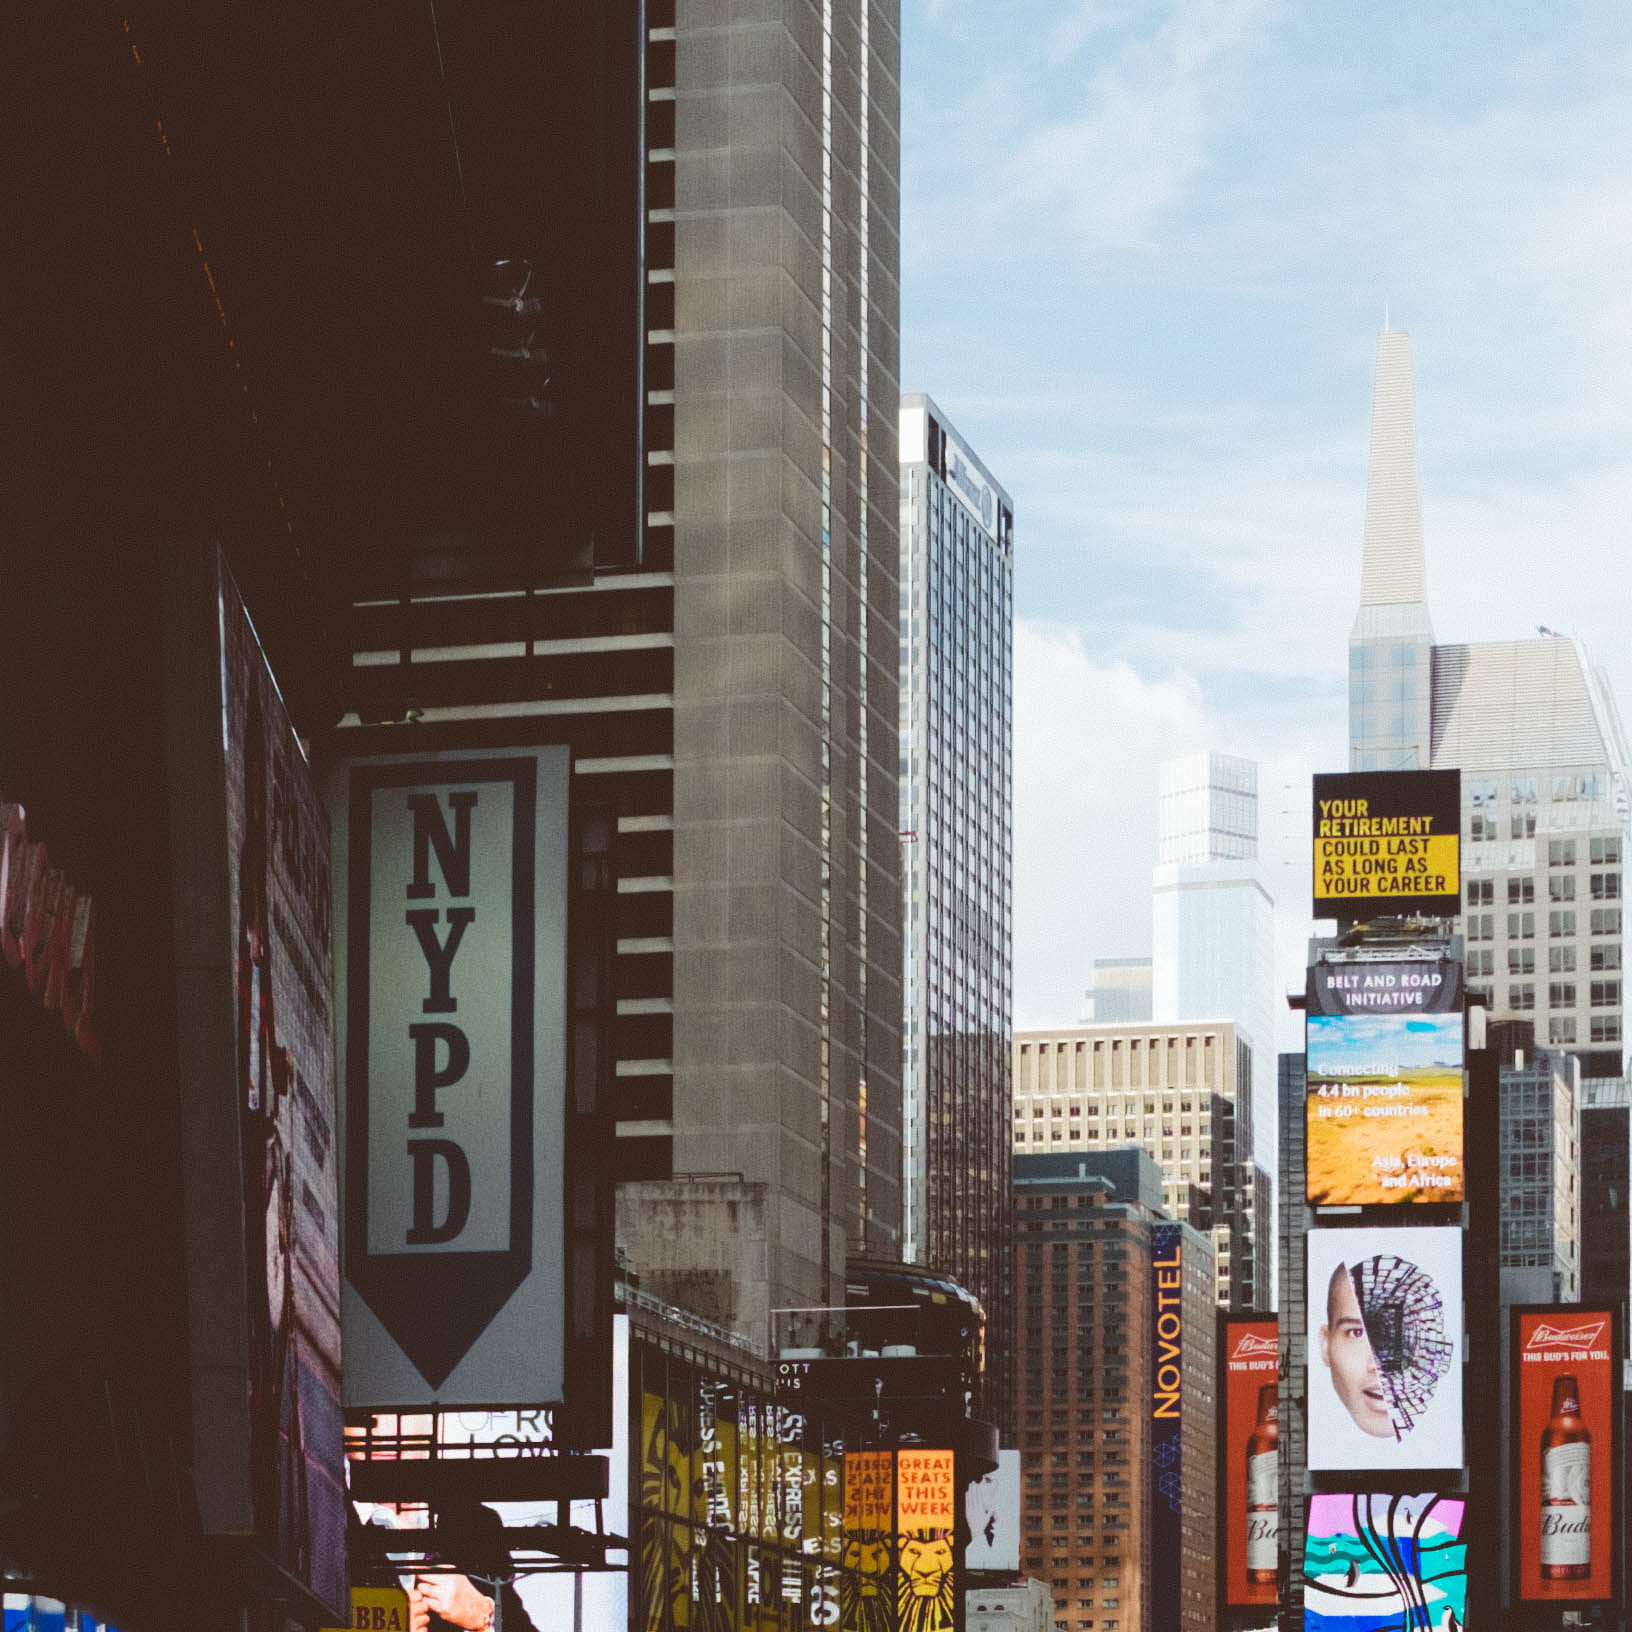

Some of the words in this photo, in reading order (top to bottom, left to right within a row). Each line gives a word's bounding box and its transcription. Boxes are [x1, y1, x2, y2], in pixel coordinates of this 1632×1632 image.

[1319, 799, 1368, 818] YOUR
[1319, 817, 1434, 838] RETIREMENT
[1322, 840, 1380, 858] COULD
[1387, 838, 1431, 856] LAST
[1322, 859, 1345, 876] AS
[1352, 858, 1398, 875] LONG
[1405, 857, 1428, 874] AS
[1323, 877, 1370, 894] YOUR
[1377, 875, 1446, 892] CAREER
[1327, 975, 1359, 989] BELT
[1363, 974, 1396, 988] AND
[1401, 973, 1442, 987] ROAD
[1346, 991, 1423, 1006] INITIATIVE
[405, 791, 480, 1245] NYPD
[1318, 1084, 1339, 1098] 4.4
[1342, 1083, 1360, 1097] bn
[1362, 1082, 1411, 1099] people
[1363, 1102, 1428, 1117] countries
[1407, 1154, 1457, 1169] Europe
[1381, 1174, 1407, 1188] and
[1409, 1173, 1452, 1187] Africa
[1152, 1246, 1181, 1419] NOVOTEL
[1522, 1352, 1542, 1362] THIS
[1543, 1352, 1570, 1362] BUD'S
[1570, 1351, 1588, 1361] FOR
[1228, 1361, 1247, 1371] THIS
[1249, 1360, 1275, 1371] BUD'S
[899, 1457, 952, 1470] GREAT
[900, 1471, 951, 1485] SEATS
[904, 1486, 947, 1500] THIS
[900, 1502, 951, 1516] WEEK
[353, 1606, 402, 1632] BBA
